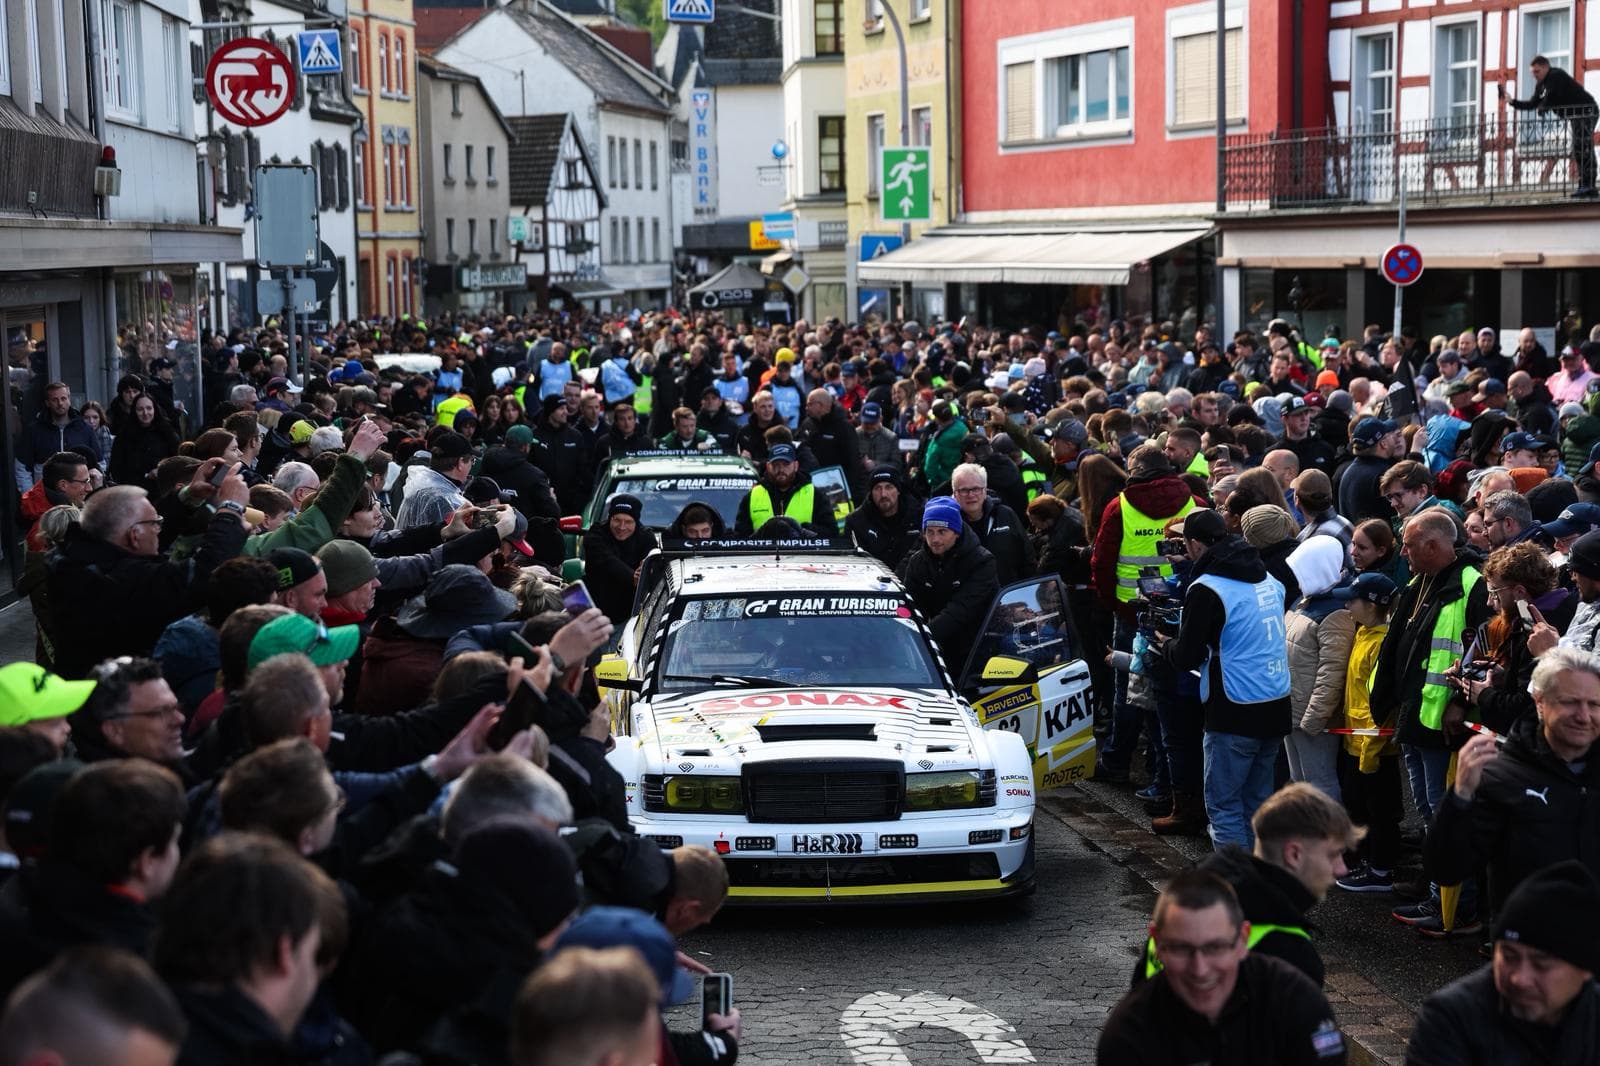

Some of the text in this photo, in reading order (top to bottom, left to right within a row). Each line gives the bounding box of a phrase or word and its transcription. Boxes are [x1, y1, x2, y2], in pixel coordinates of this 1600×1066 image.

[696, 108, 707, 137] VR
[697, 147, 708, 203] Bank
[677, 479, 706, 487] GRAN
[709, 479, 752, 487] TURISMO
[1135, 528, 1154, 536] MSC
[776, 539, 830, 547] IMPULSE
[779, 598, 824, 610] GRAN
[830, 598, 898, 610] TURISMO
[701, 693, 913, 715] SONAX
[986, 691, 1032, 714] RAVENOL
[1042, 765, 1086, 788] PROTEC
[1006, 788, 1031, 797] SONAX
[792, 834, 836, 854] H&R
